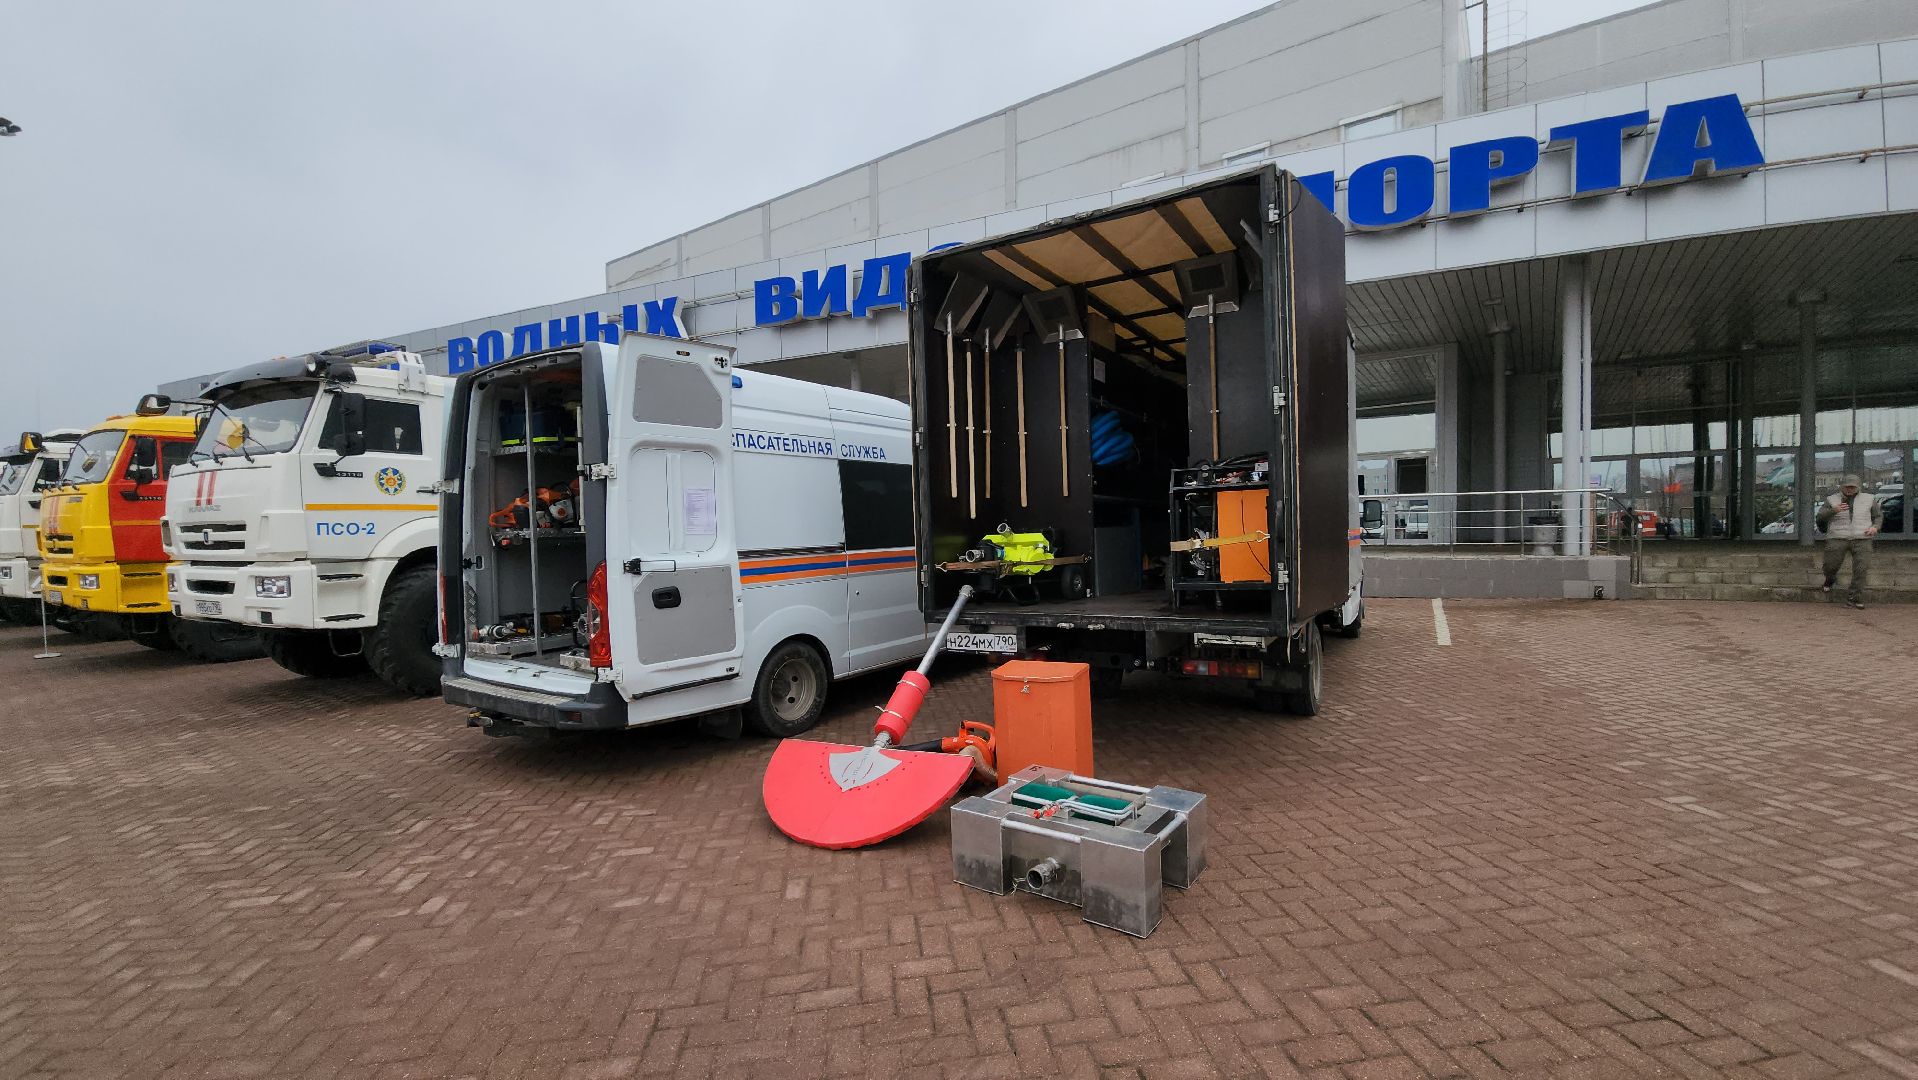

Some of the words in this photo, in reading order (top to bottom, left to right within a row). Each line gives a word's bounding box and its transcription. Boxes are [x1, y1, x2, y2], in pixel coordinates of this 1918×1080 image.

[447, 296, 688, 376] ВОДНЫХ
[754, 241, 966, 328] ВИД
[840, 443, 887, 460] СЛУЖБА
[316, 522, 376, 536] ПСО-2
